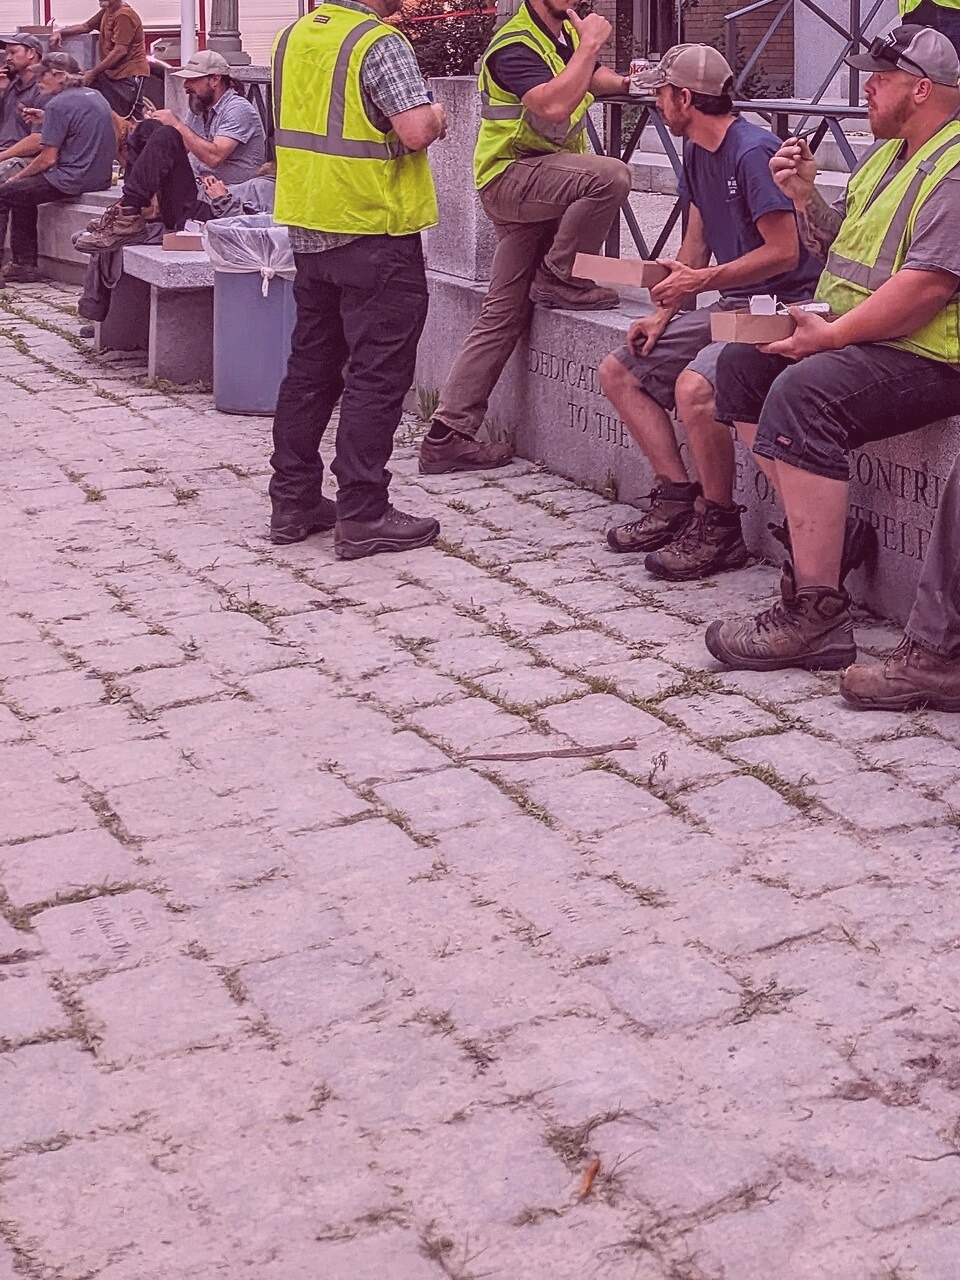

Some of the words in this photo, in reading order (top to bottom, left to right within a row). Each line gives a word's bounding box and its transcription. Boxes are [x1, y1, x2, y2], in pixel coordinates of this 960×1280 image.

[567, 402, 588, 433] TO
[595, 412, 630, 449] THE
[849, 450, 947, 509] ONTRI
